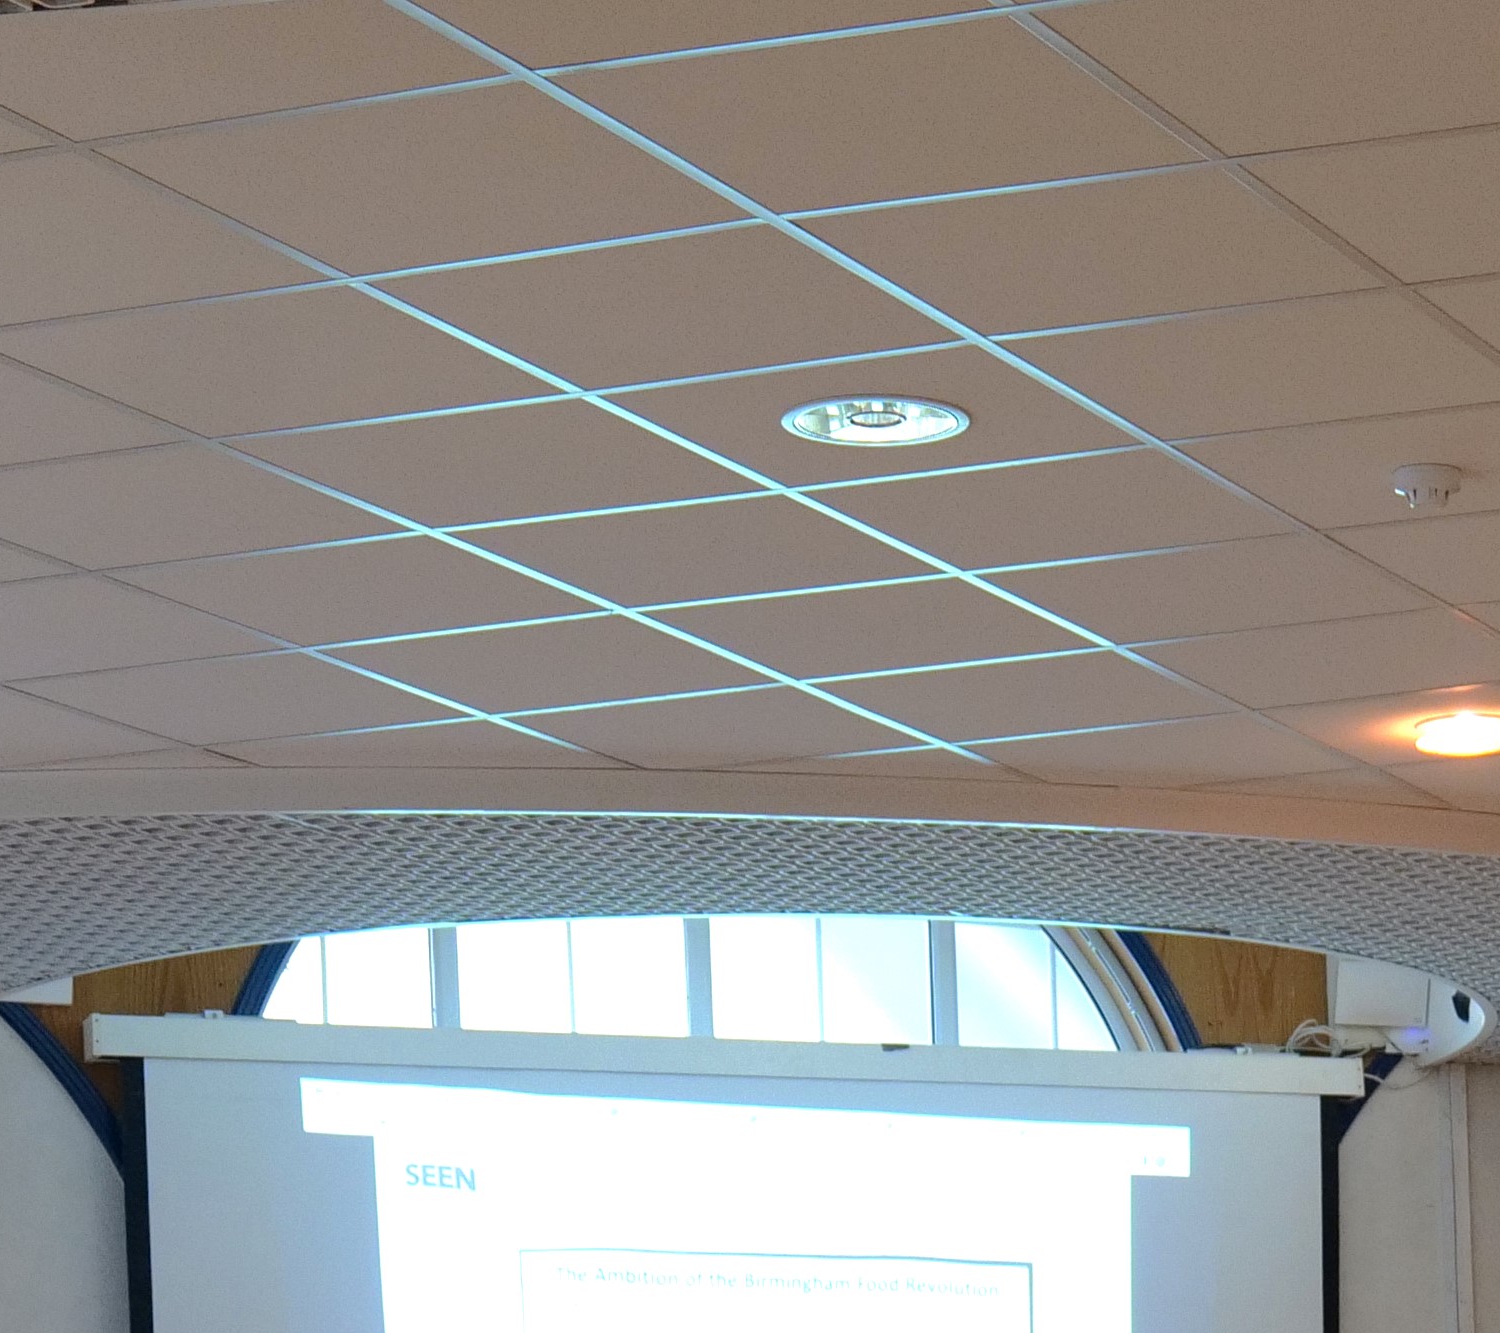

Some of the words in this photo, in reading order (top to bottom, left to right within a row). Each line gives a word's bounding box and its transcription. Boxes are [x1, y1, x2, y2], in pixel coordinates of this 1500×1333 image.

[406, 1163, 476, 1191] SEEN
[595, 1267, 679, 1286] Ambition
[685, 1271, 702, 1287] of
[709, 1271, 737, 1288] the
[744, 1272, 850, 1294] Birmingham
[858, 1276, 900, 1292] Food
[906, 1277, 999, 1297] Revolution
